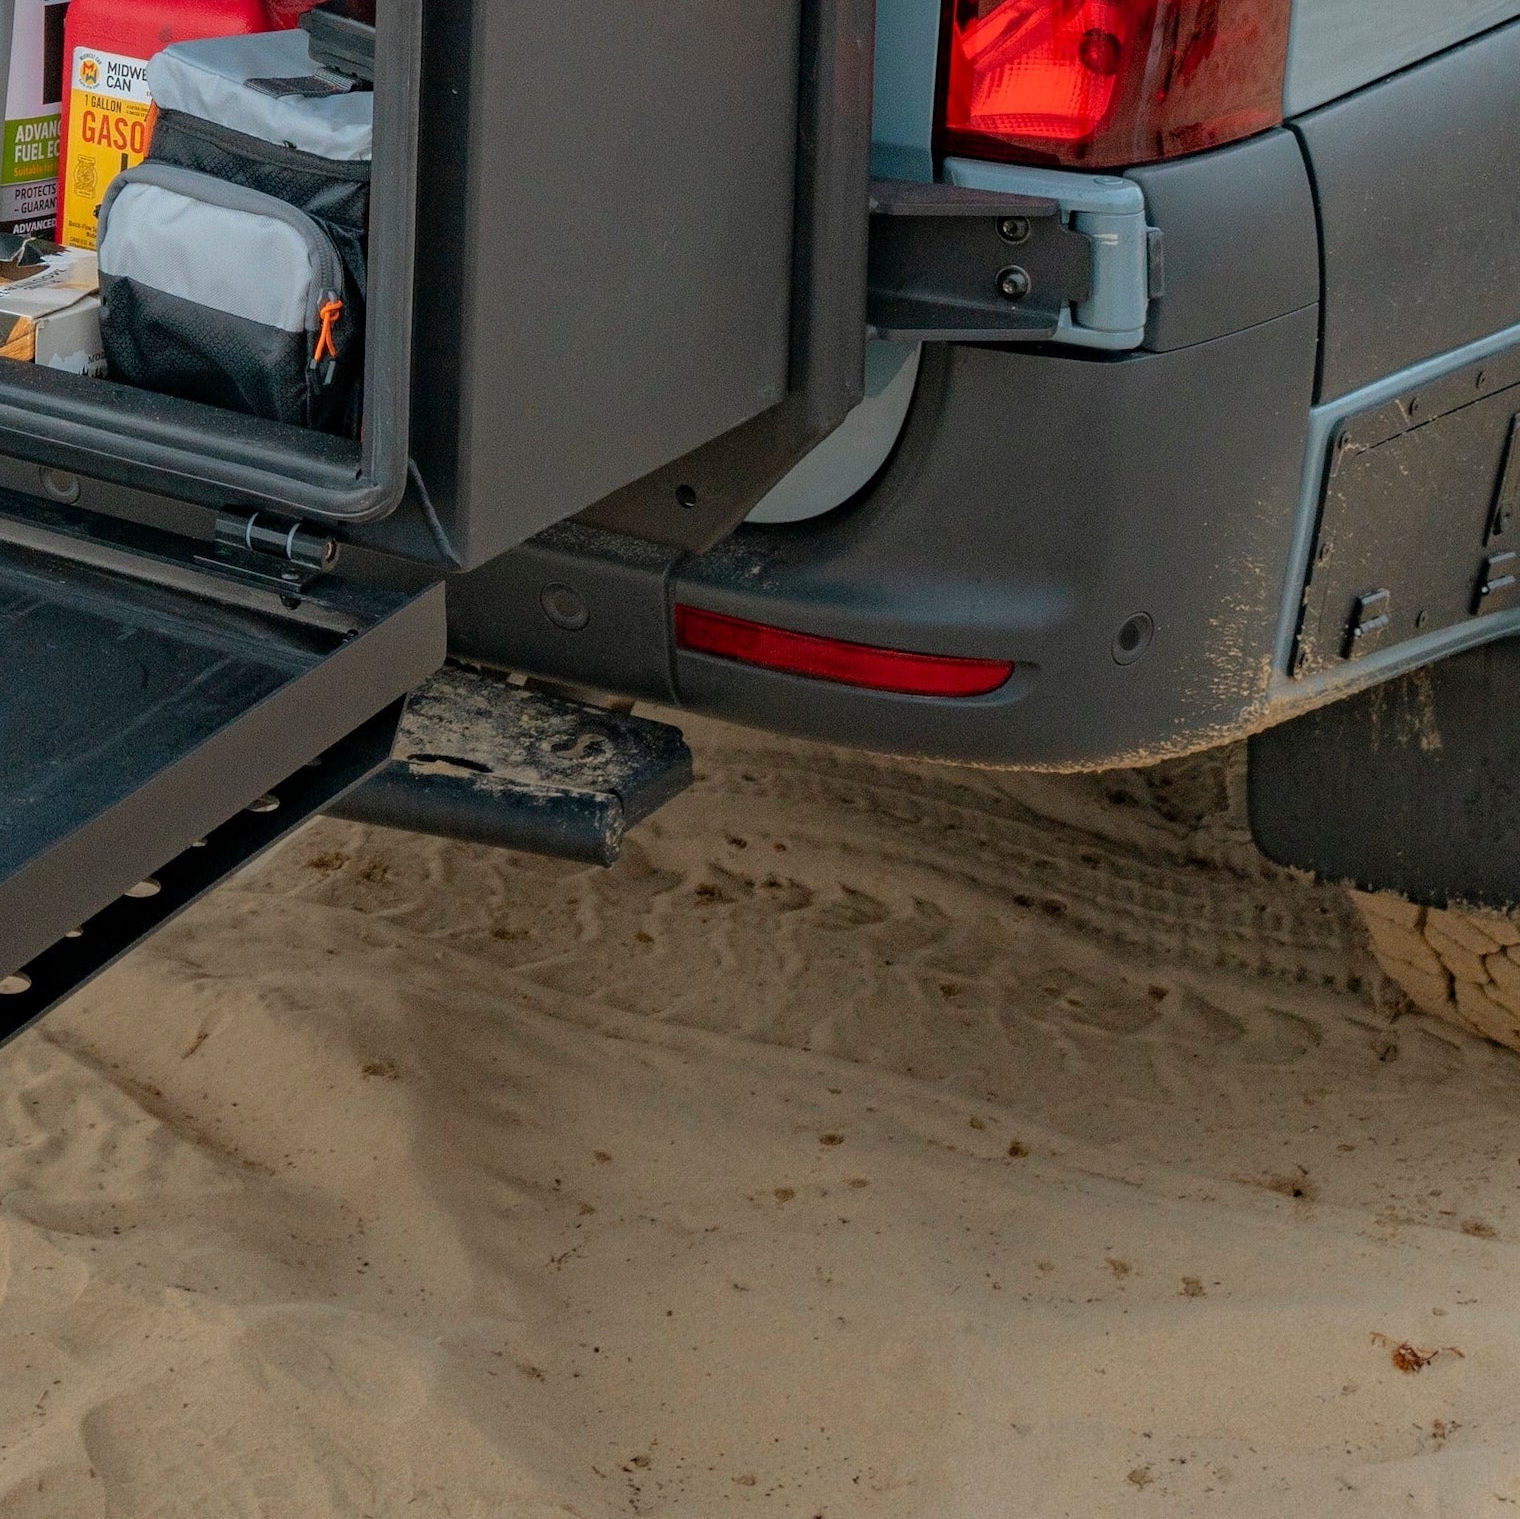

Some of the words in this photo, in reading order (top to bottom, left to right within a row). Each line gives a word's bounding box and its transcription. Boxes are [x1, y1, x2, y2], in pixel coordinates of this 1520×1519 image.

[106, 75, 132, 92] CAN
[85, 94, 90, 106] 1
[91, 95, 122, 114] GALLON
[82, 110, 145, 154] GASO
[15, 142, 44, 162] FUEL
[15, 183, 56, 200] PROTECTS
[13, 218, 57, 235] ADVANCED
